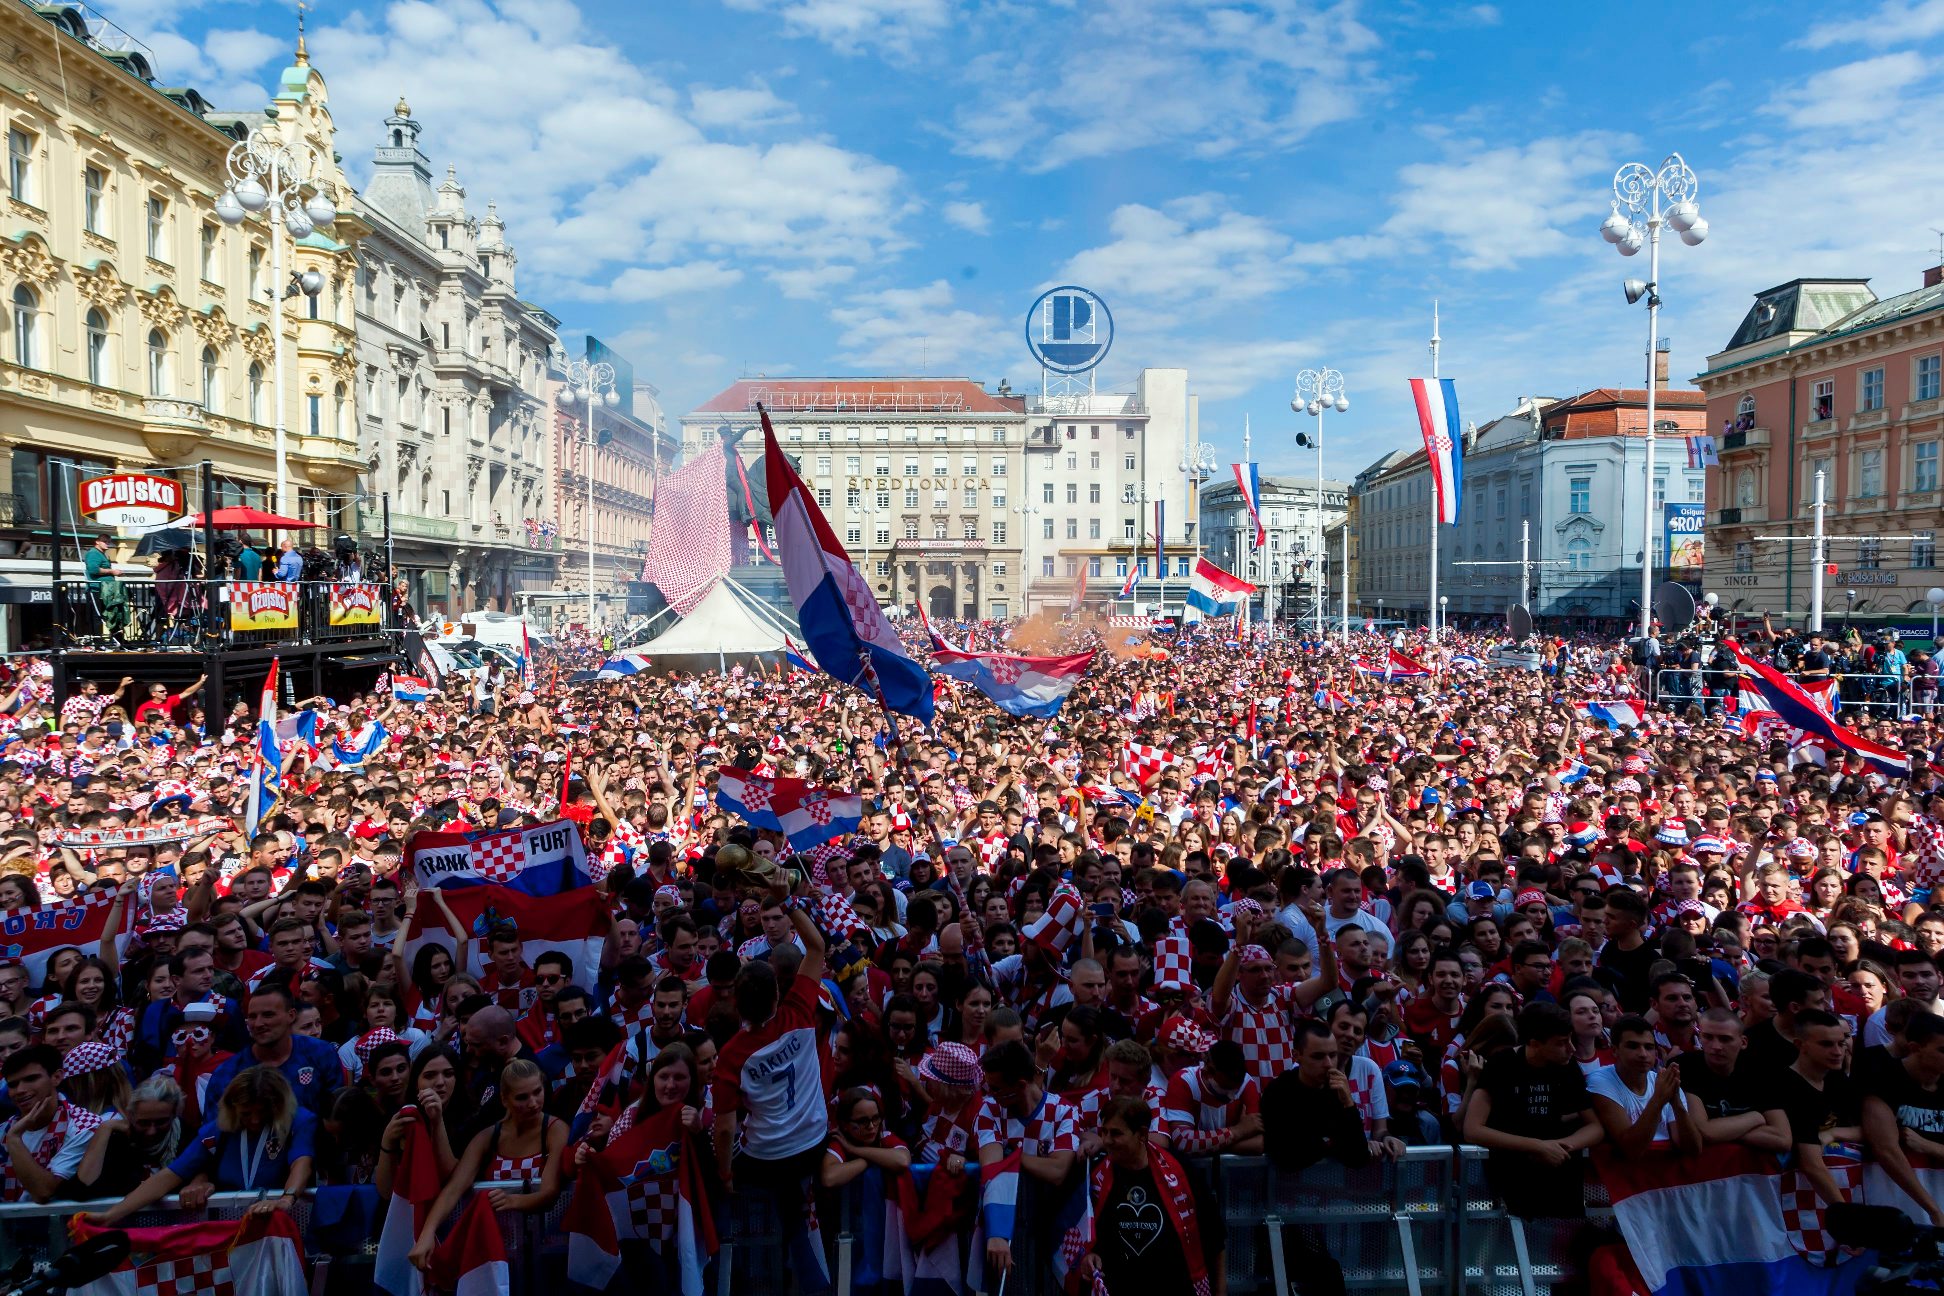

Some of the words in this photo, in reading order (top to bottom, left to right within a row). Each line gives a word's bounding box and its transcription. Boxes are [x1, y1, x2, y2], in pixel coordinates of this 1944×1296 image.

[88, 476, 175, 508] Ožujsko
[848, 476, 991, 491] ŠTEDIONICA
[121, 513, 146, 524] Pivo
[1671, 516, 1705, 532] ROA
[1724, 575, 1759, 586] SINGER
[251, 590, 287, 612] Ožujsko
[418, 853, 470, 878] FRANK
[530, 827, 572, 856] FURT
[747, 1035, 801, 1081] RAKITIĆ
[771, 1062, 796, 1111] 7
